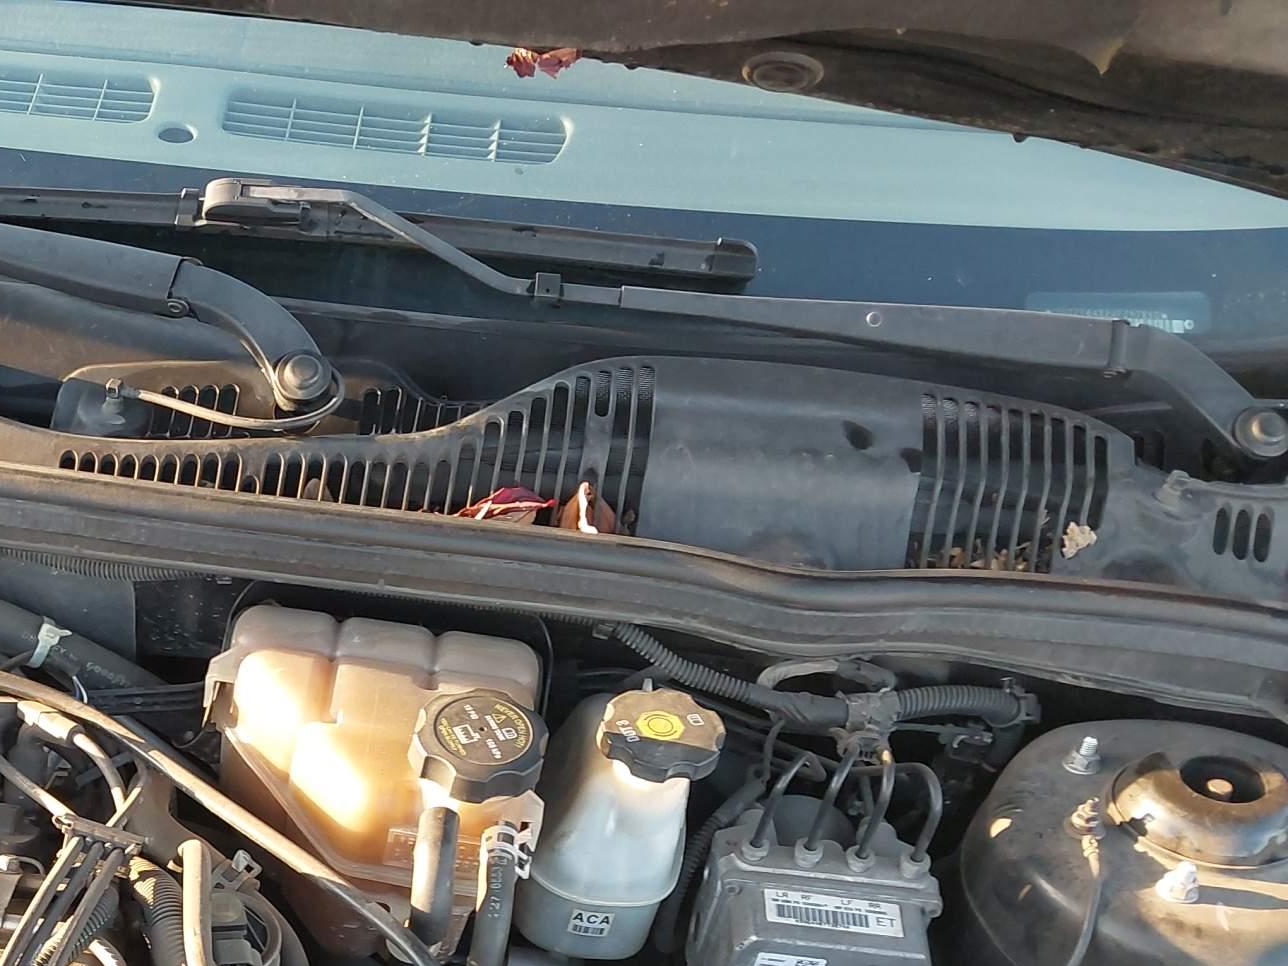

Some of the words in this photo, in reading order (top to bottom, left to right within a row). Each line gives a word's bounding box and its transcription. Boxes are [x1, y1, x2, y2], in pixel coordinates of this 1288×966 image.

[615, 719, 626, 727] 3
[618, 726, 641, 743] DOT
[775, 891, 789, 899] LR
[572, 912, 611, 926] ACA
[876, 917, 896, 928] ET
